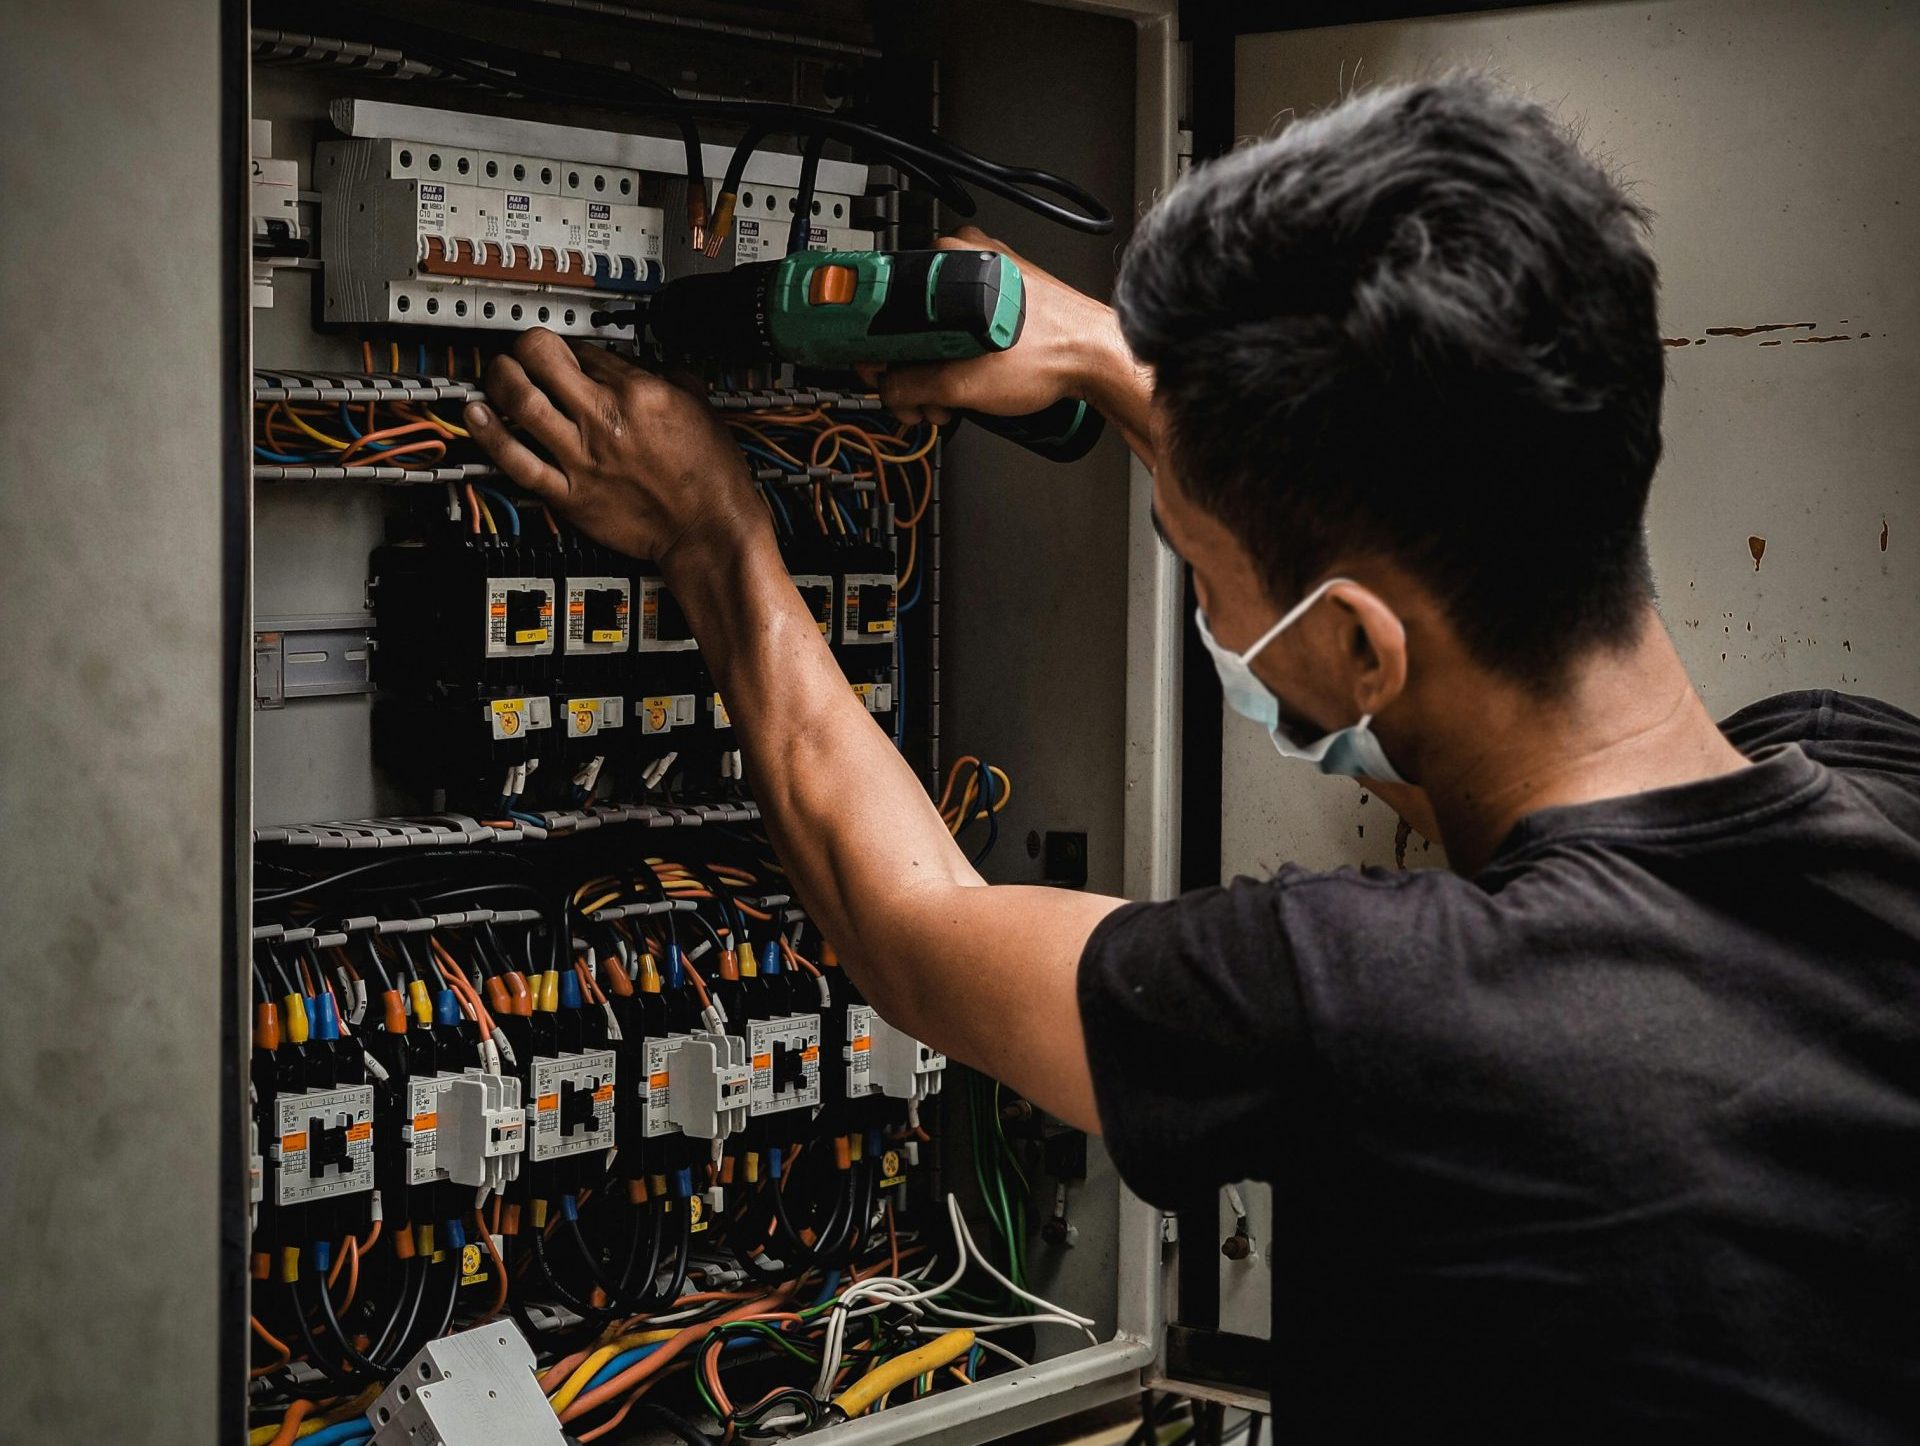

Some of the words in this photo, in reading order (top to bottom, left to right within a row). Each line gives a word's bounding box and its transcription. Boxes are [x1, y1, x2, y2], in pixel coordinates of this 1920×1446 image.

[422, 185, 437, 193] MAX
[421, 193, 443, 201] GUARD
[419, 210, 431, 218] C10
[589, 211, 609, 219] GUARD
[505, 219, 517, 228] C10
[587, 229, 599, 238] C20
[738, 243, 748, 252] C10
[755, 313, 765, 326] 10
